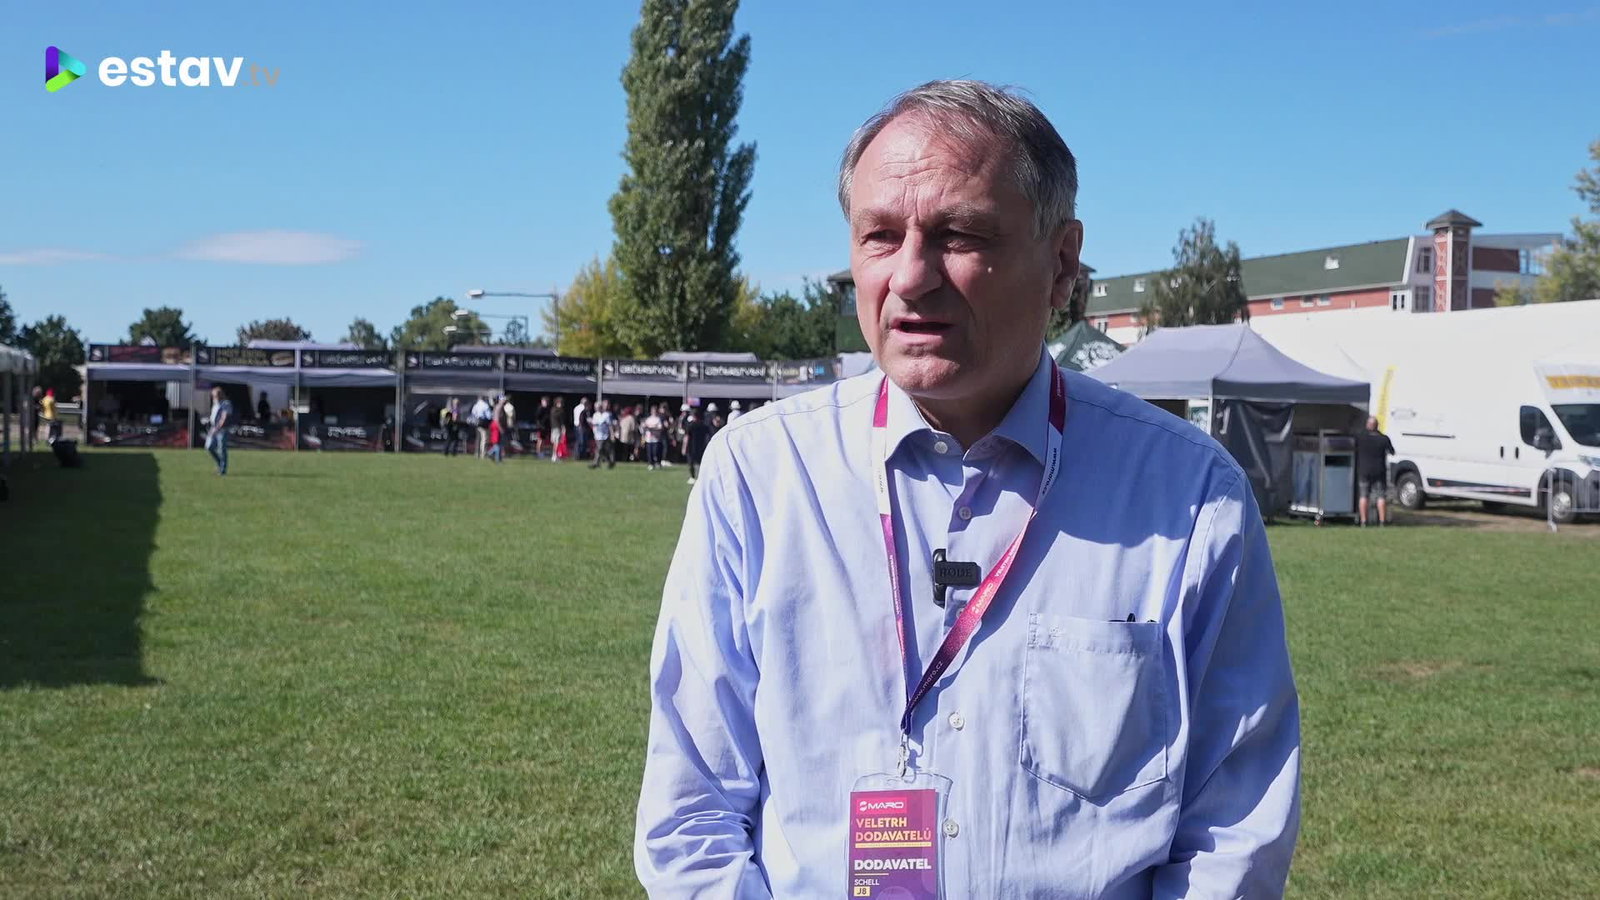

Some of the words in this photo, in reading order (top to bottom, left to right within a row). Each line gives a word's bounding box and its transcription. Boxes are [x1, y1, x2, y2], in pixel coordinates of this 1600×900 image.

[868, 801, 904, 809] MARO
[856, 817, 907, 828] VELETRH
[856, 827, 931, 841] DODAVATELŮ
[854, 858, 931, 870] DODAVATEL
